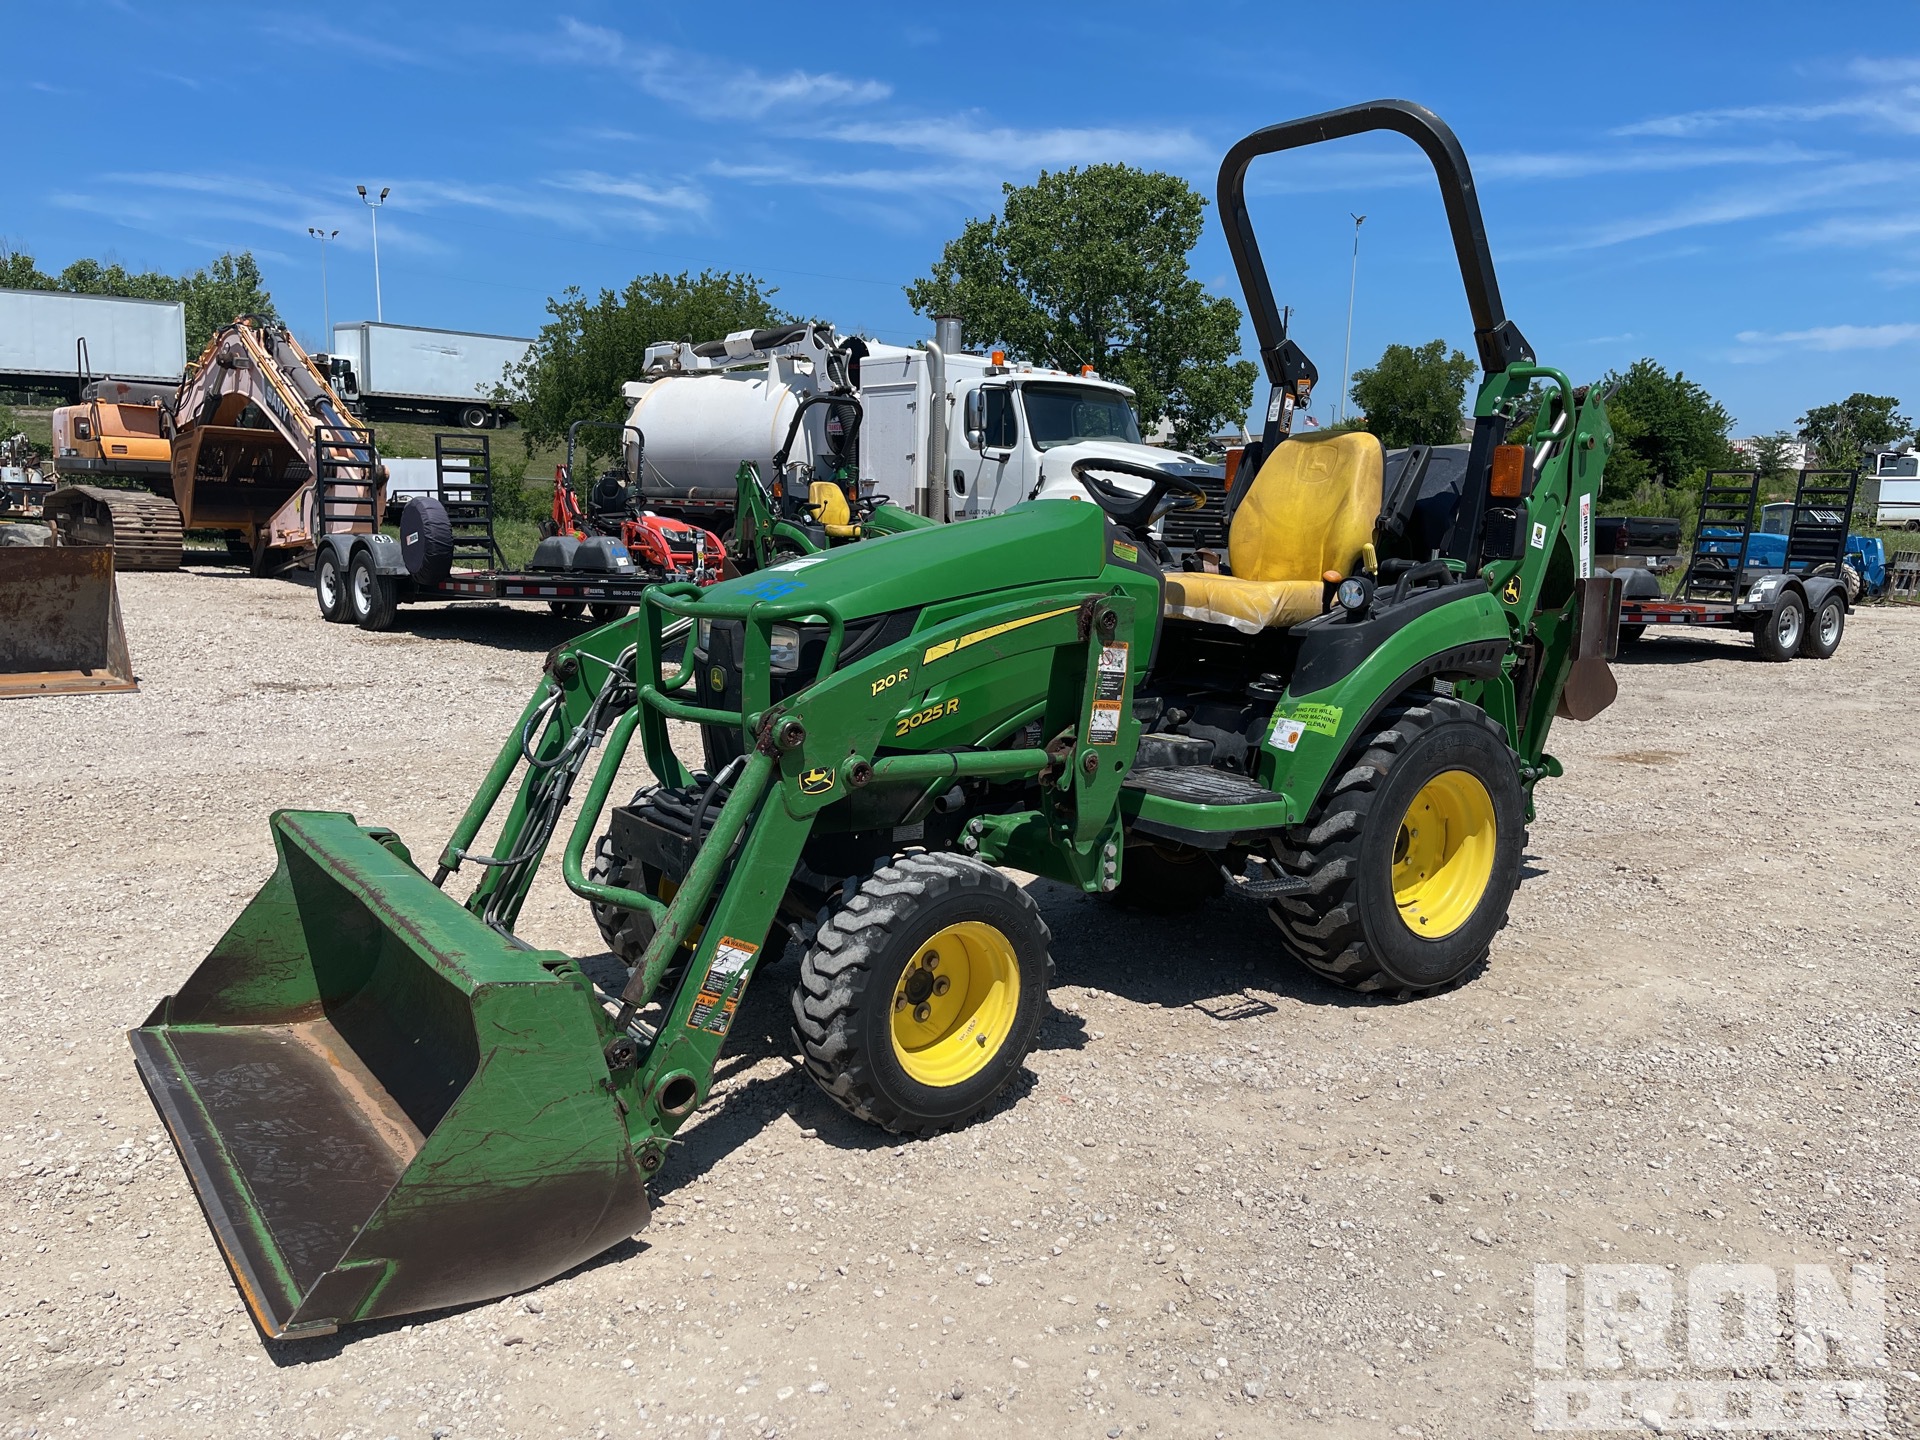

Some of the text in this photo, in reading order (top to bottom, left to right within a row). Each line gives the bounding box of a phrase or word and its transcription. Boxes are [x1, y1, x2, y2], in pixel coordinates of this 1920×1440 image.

[266, 386, 289, 422] SANY
[871, 674, 896, 697] 120
[895, 702, 944, 737] 2025
[1306, 721, 1327, 729] CLEAN
[1309, 714, 1337, 725] MACHINE
[730, 940, 755, 952] WARNING
